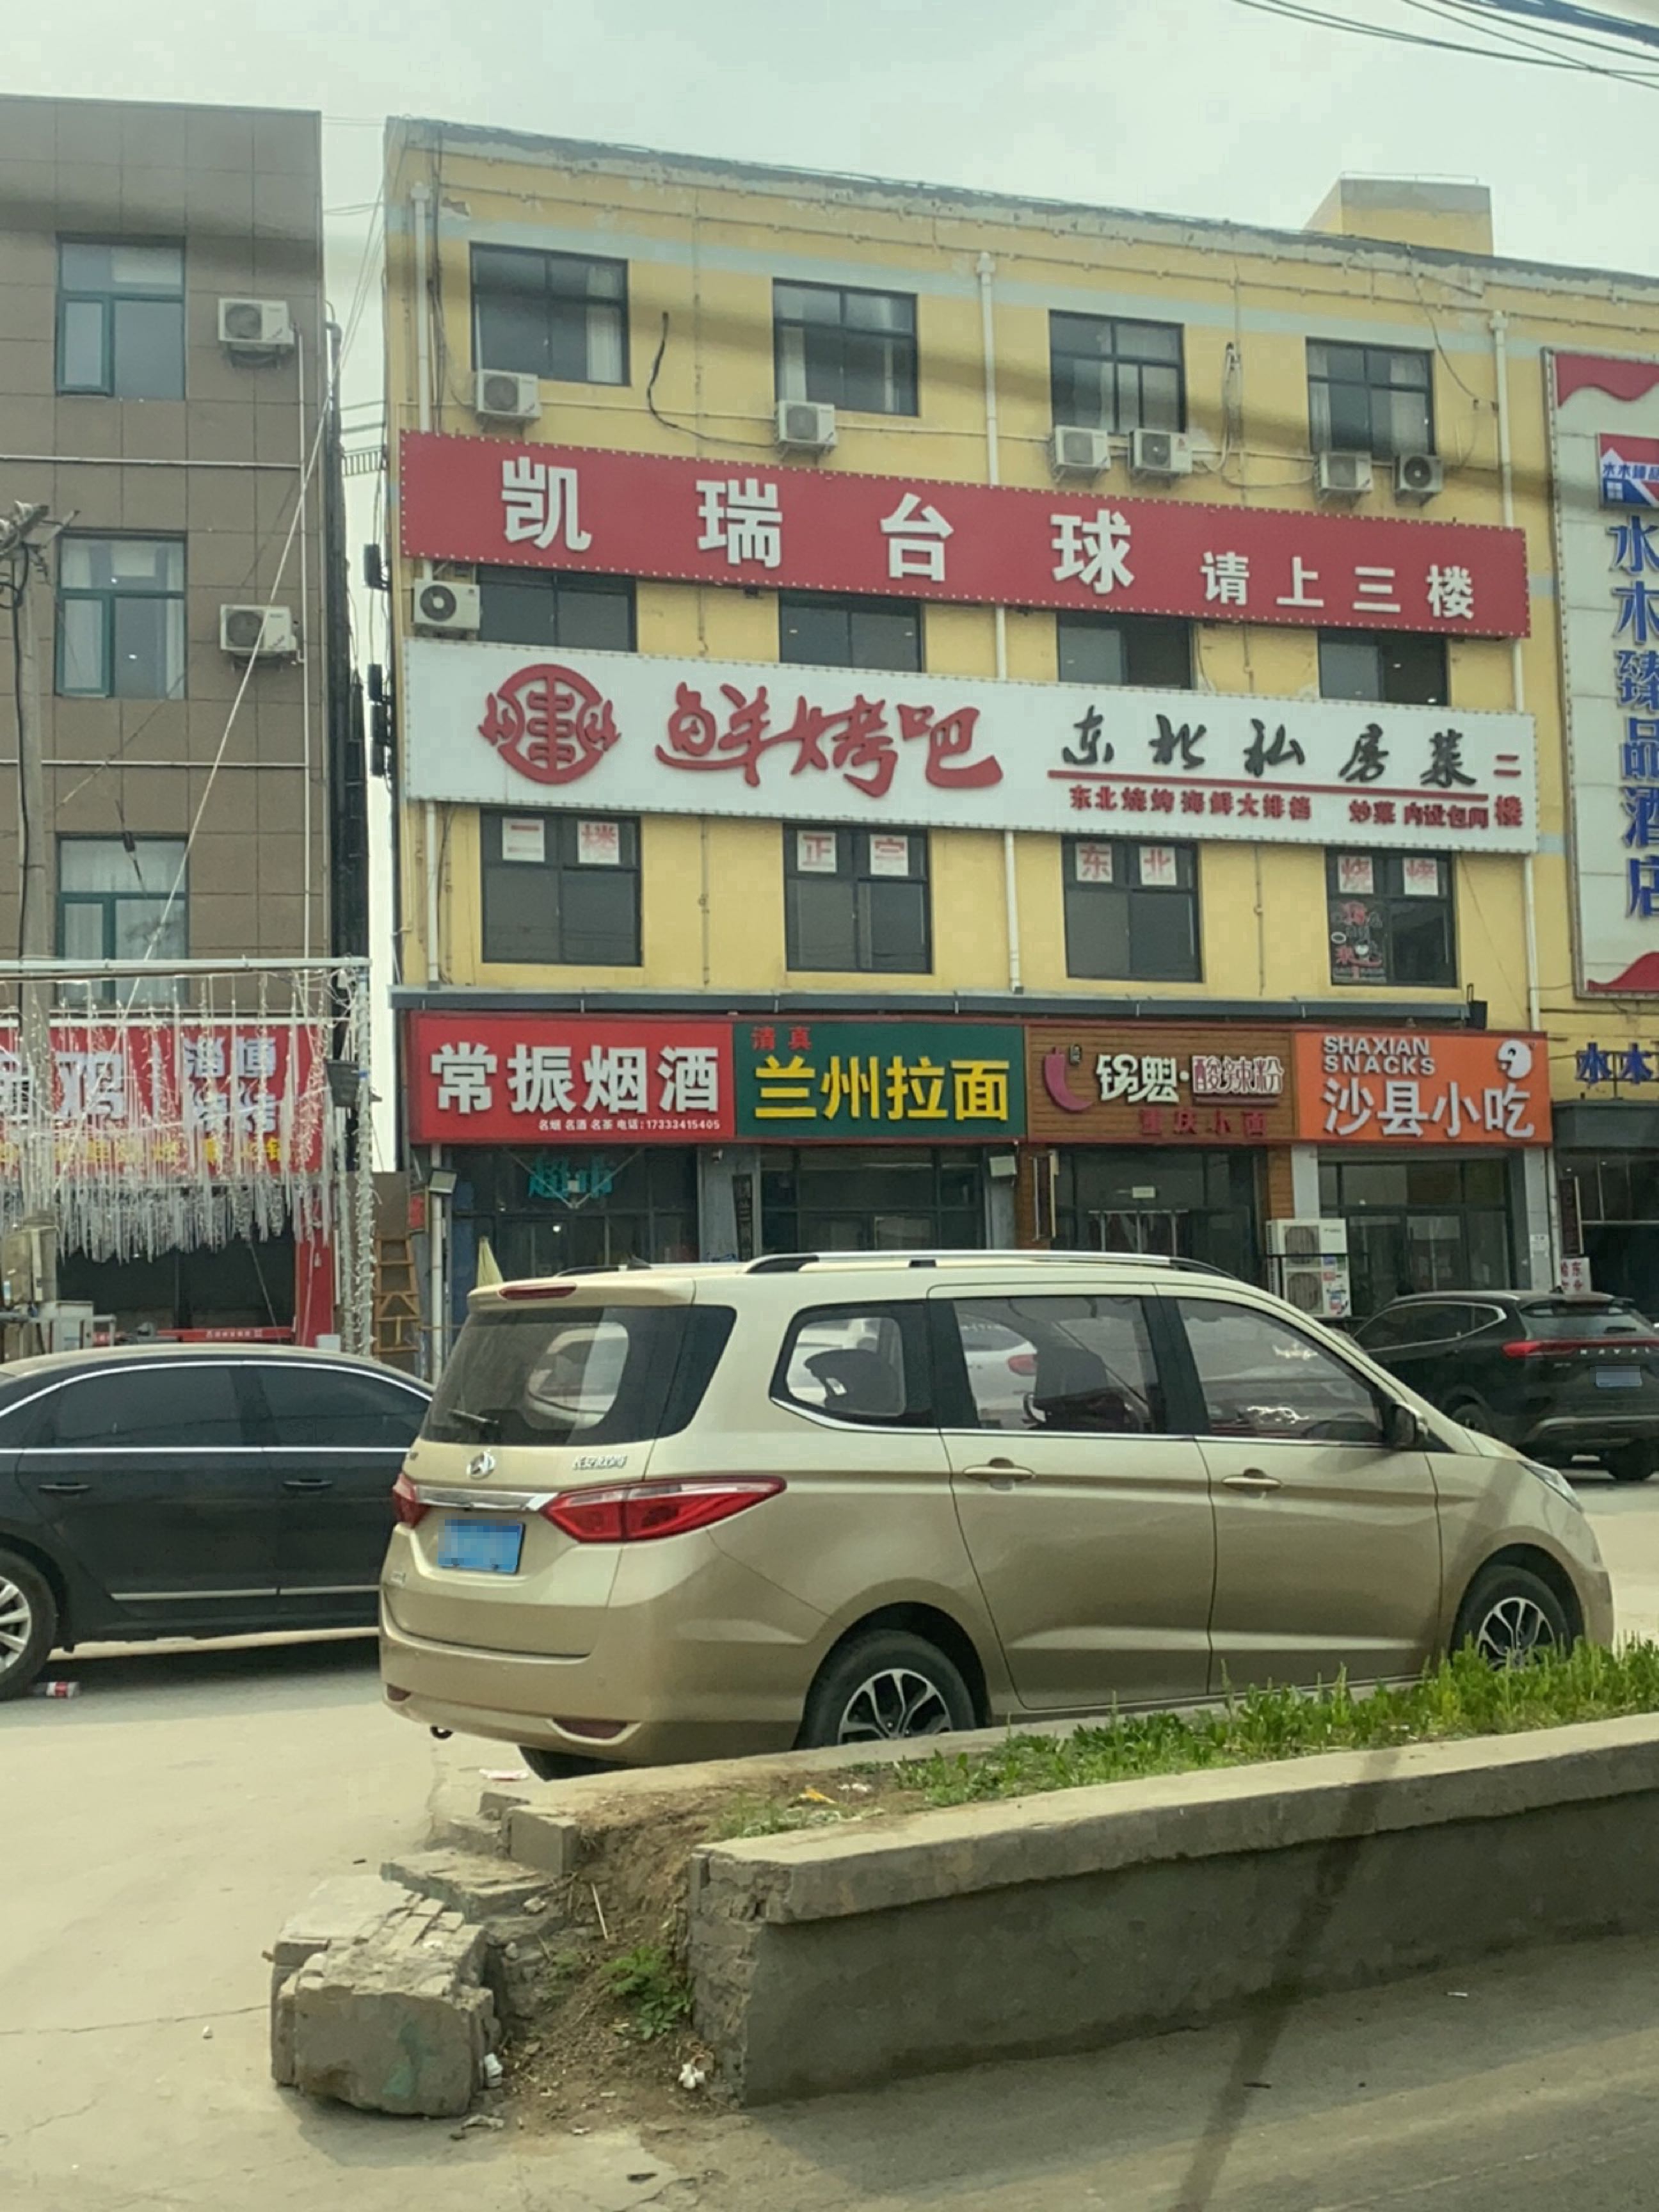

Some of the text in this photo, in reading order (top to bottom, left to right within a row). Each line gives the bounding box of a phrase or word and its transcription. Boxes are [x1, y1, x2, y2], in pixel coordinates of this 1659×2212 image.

[501, 456, 1475, 620] 凯瑞台球 请上三楼
[655, 682, 1003, 797] 鲜烤吧
[1062, 705, 1477, 788] 东北私房菜
[1070, 785, 1311, 820] 东北烧烤海鲜大排档
[1493, 755, 1523, 826] 二楼
[751, 1026, 812, 1050] 清真
[1323, 1036, 1431, 1055] SHAXIAN
[1323, 1055, 1436, 1075] SNACKS
[429, 1041, 719, 1114] 常振烟酒
[755, 1055, 1010, 1121] 兰州拉面
[1322, 1077, 1535, 1138] 沙县小吃
